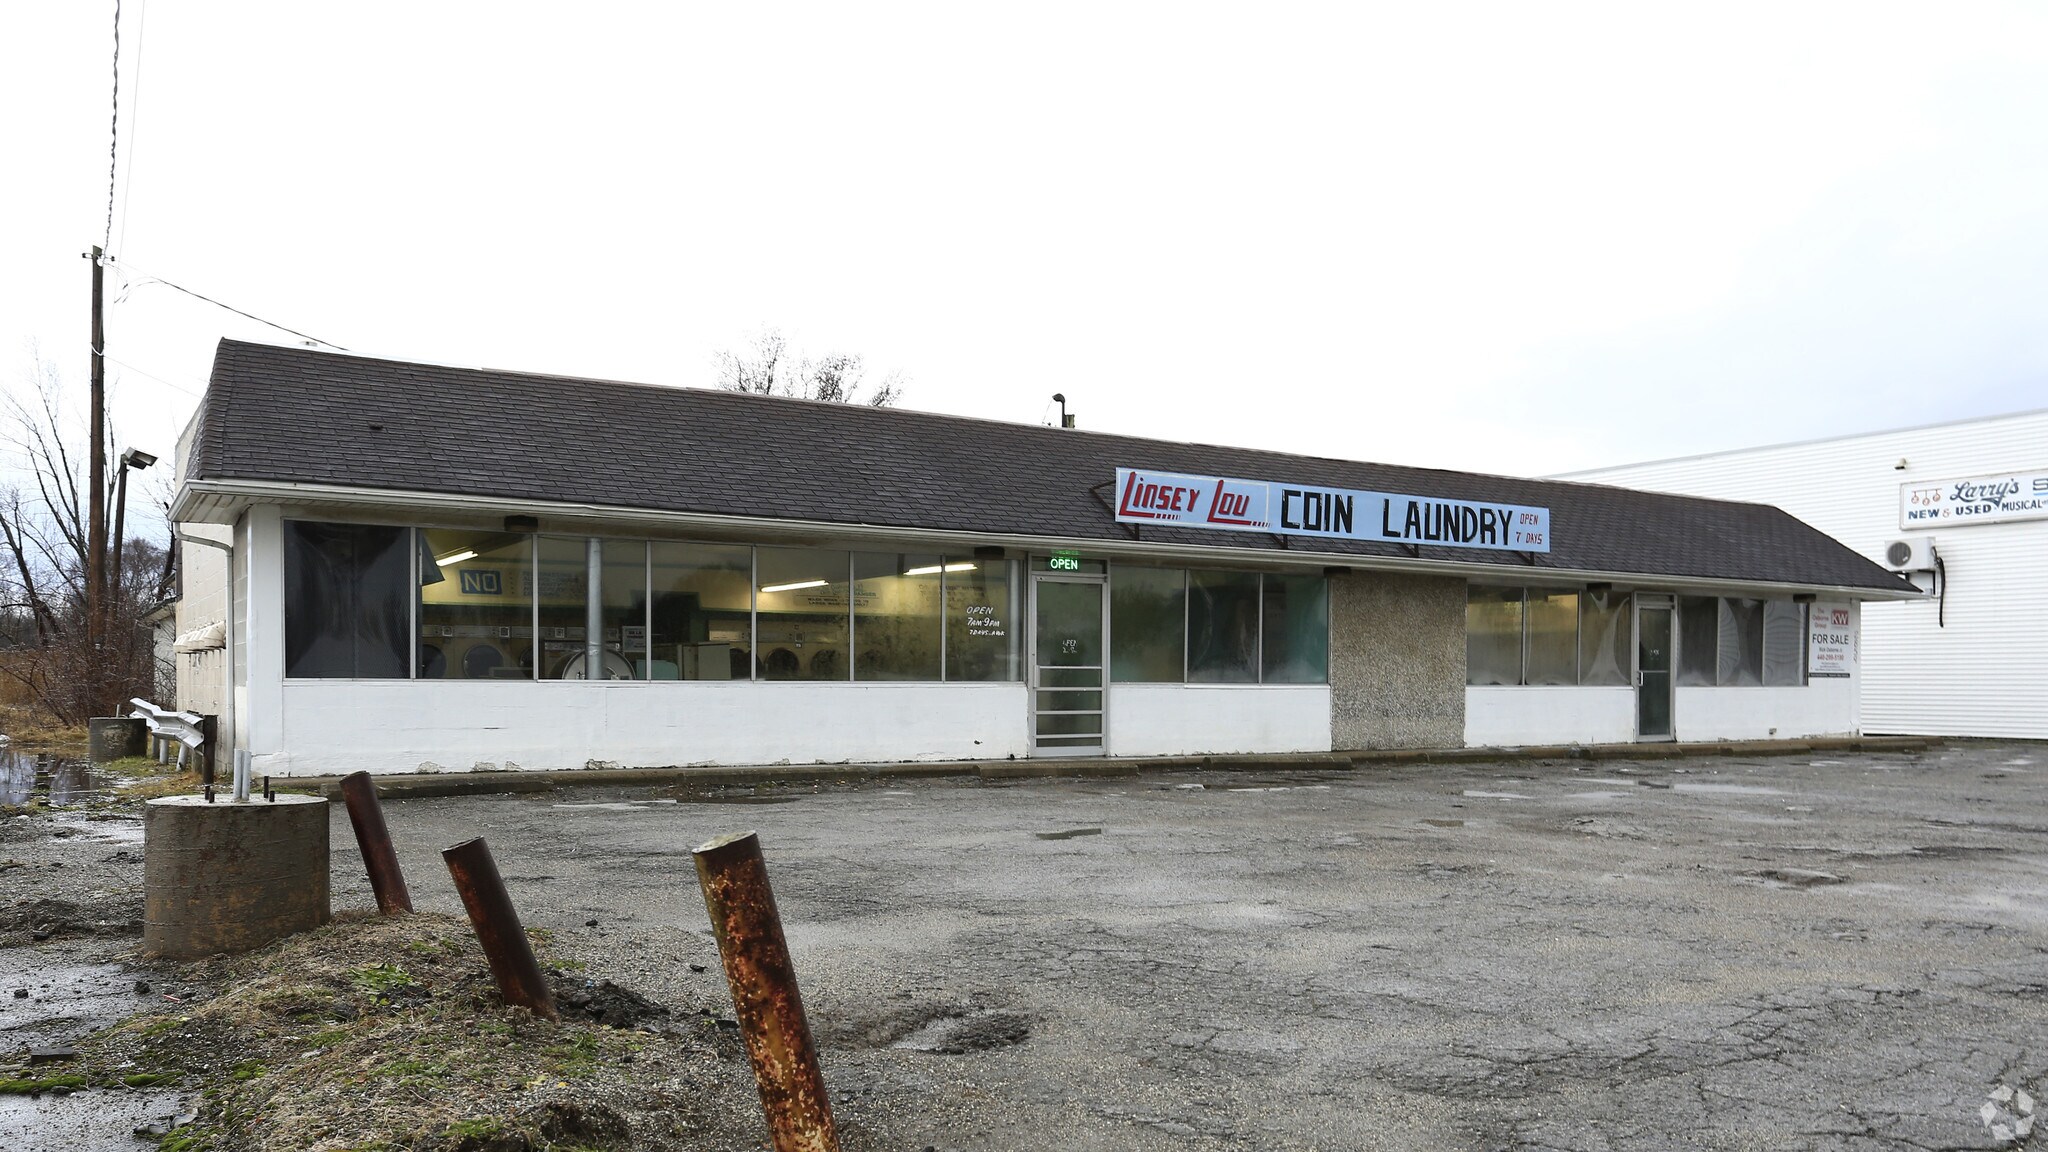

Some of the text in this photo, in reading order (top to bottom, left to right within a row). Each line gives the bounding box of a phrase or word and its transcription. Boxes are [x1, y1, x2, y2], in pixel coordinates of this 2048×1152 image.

[1949, 478, 2020, 508] Larry's
[1908, 508, 1940, 520] NEW
[1942, 509, 1952, 518] &
[1955, 504, 1992, 516] USED
[2001, 499, 2043, 512] MUSICAL
[1281, 488, 1514, 546] COIN LAUNDRY
[1519, 513, 1539, 526] OPEN
[1515, 531, 1543, 545] 7 DAYS
[1050, 558, 1078, 570] OPEN
[464, 573, 497, 592] NO
[966, 606, 994, 615] OPEN
[1831, 612, 1848, 625] KW
[1812, 633, 1849, 645] FOR SALE
